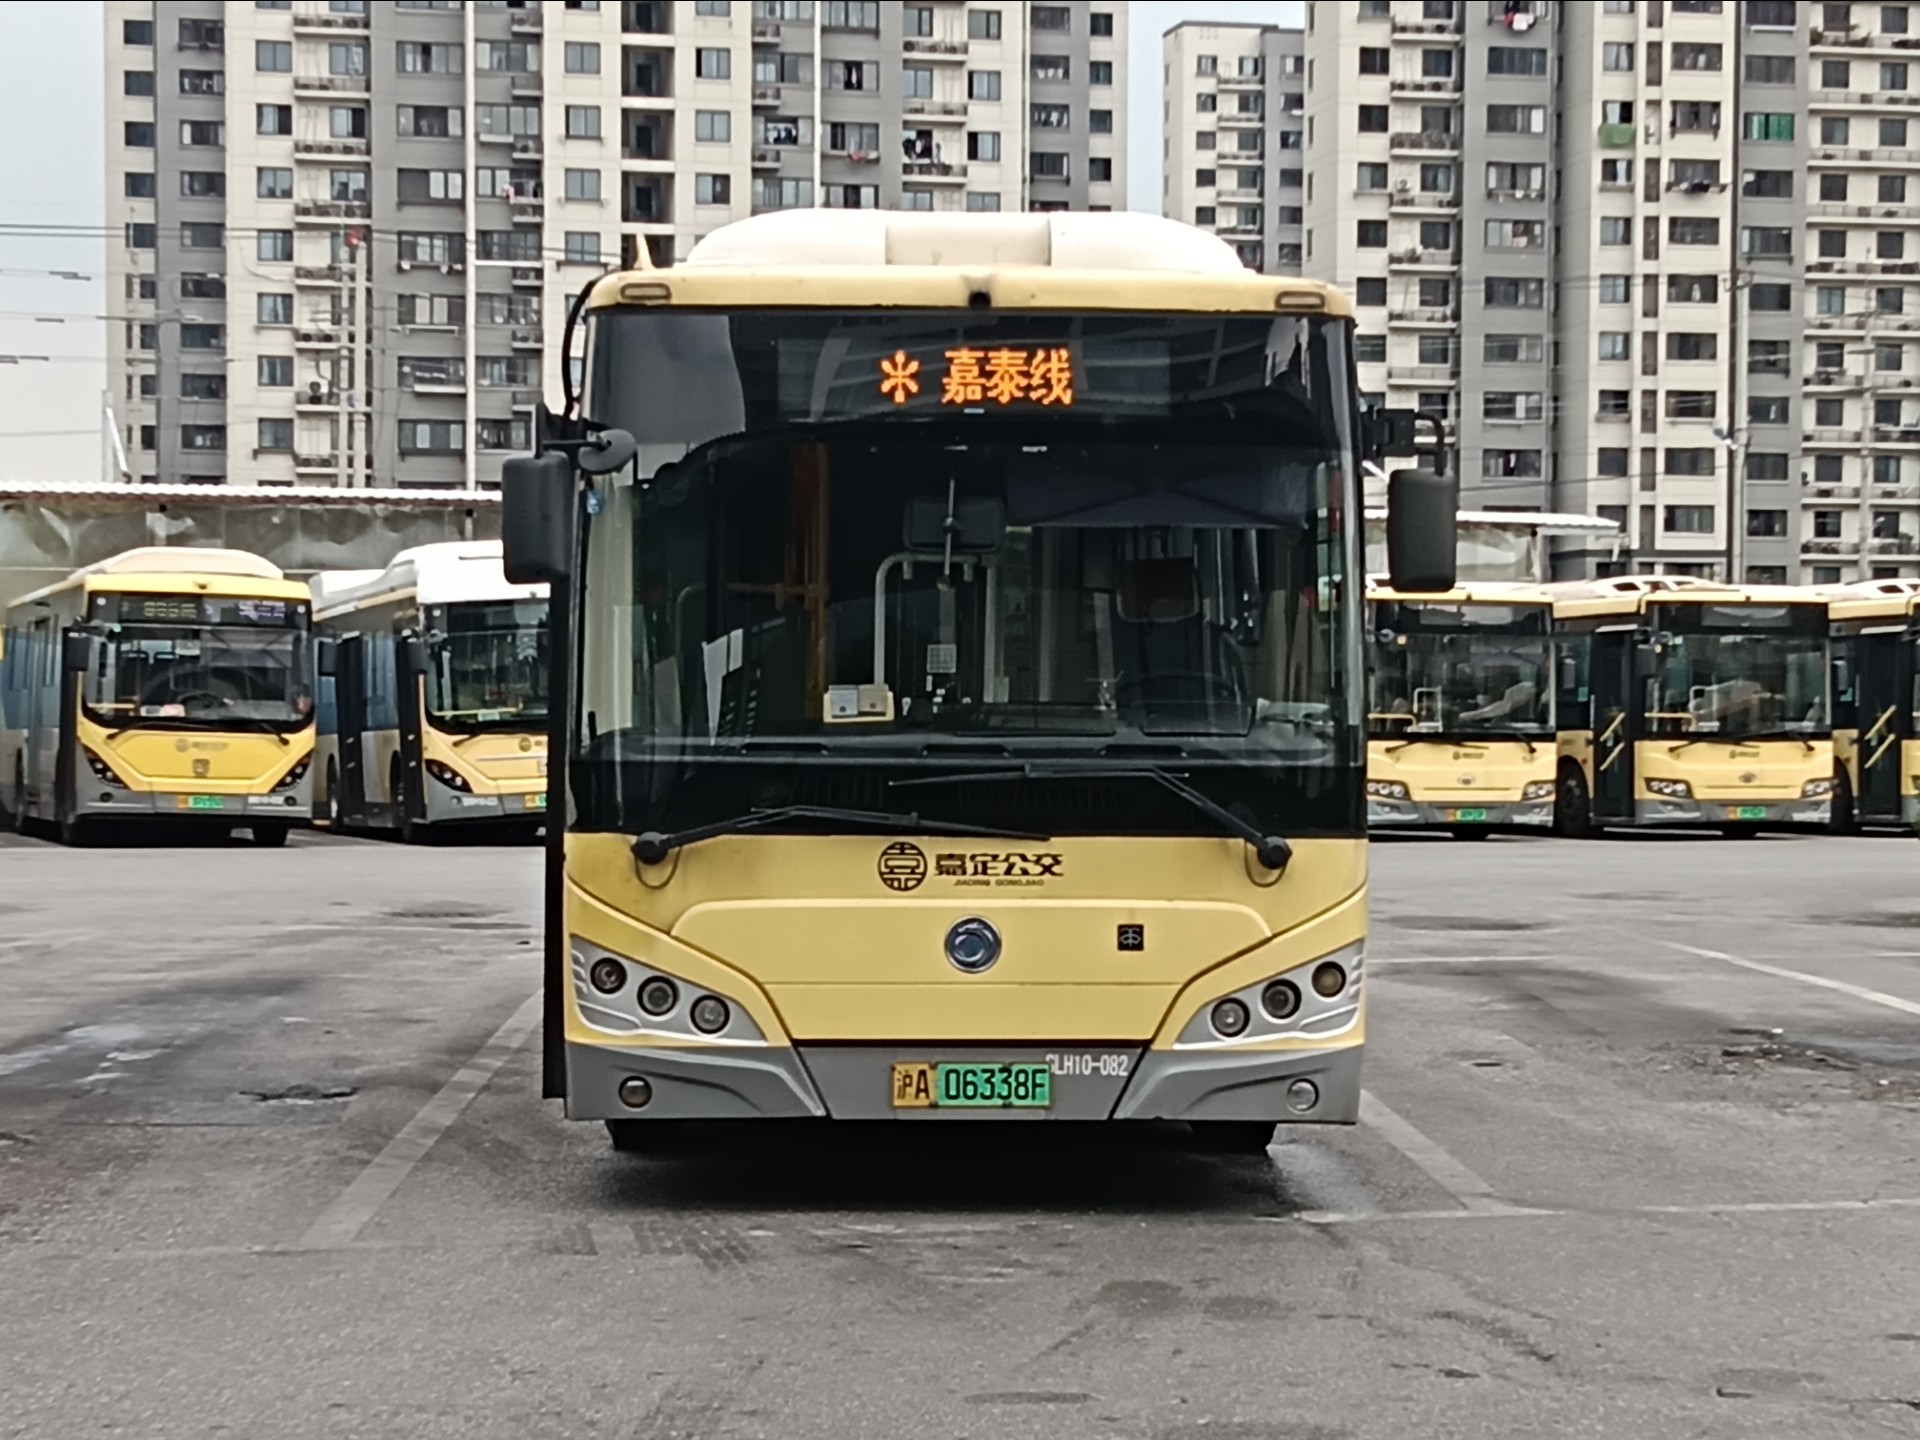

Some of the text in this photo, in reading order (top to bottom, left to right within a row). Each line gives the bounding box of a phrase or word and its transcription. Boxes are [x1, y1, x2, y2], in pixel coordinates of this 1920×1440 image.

[941, 348, 1073, 404] 嘉泰线
[934, 853, 1064, 876] 嘉定公交
